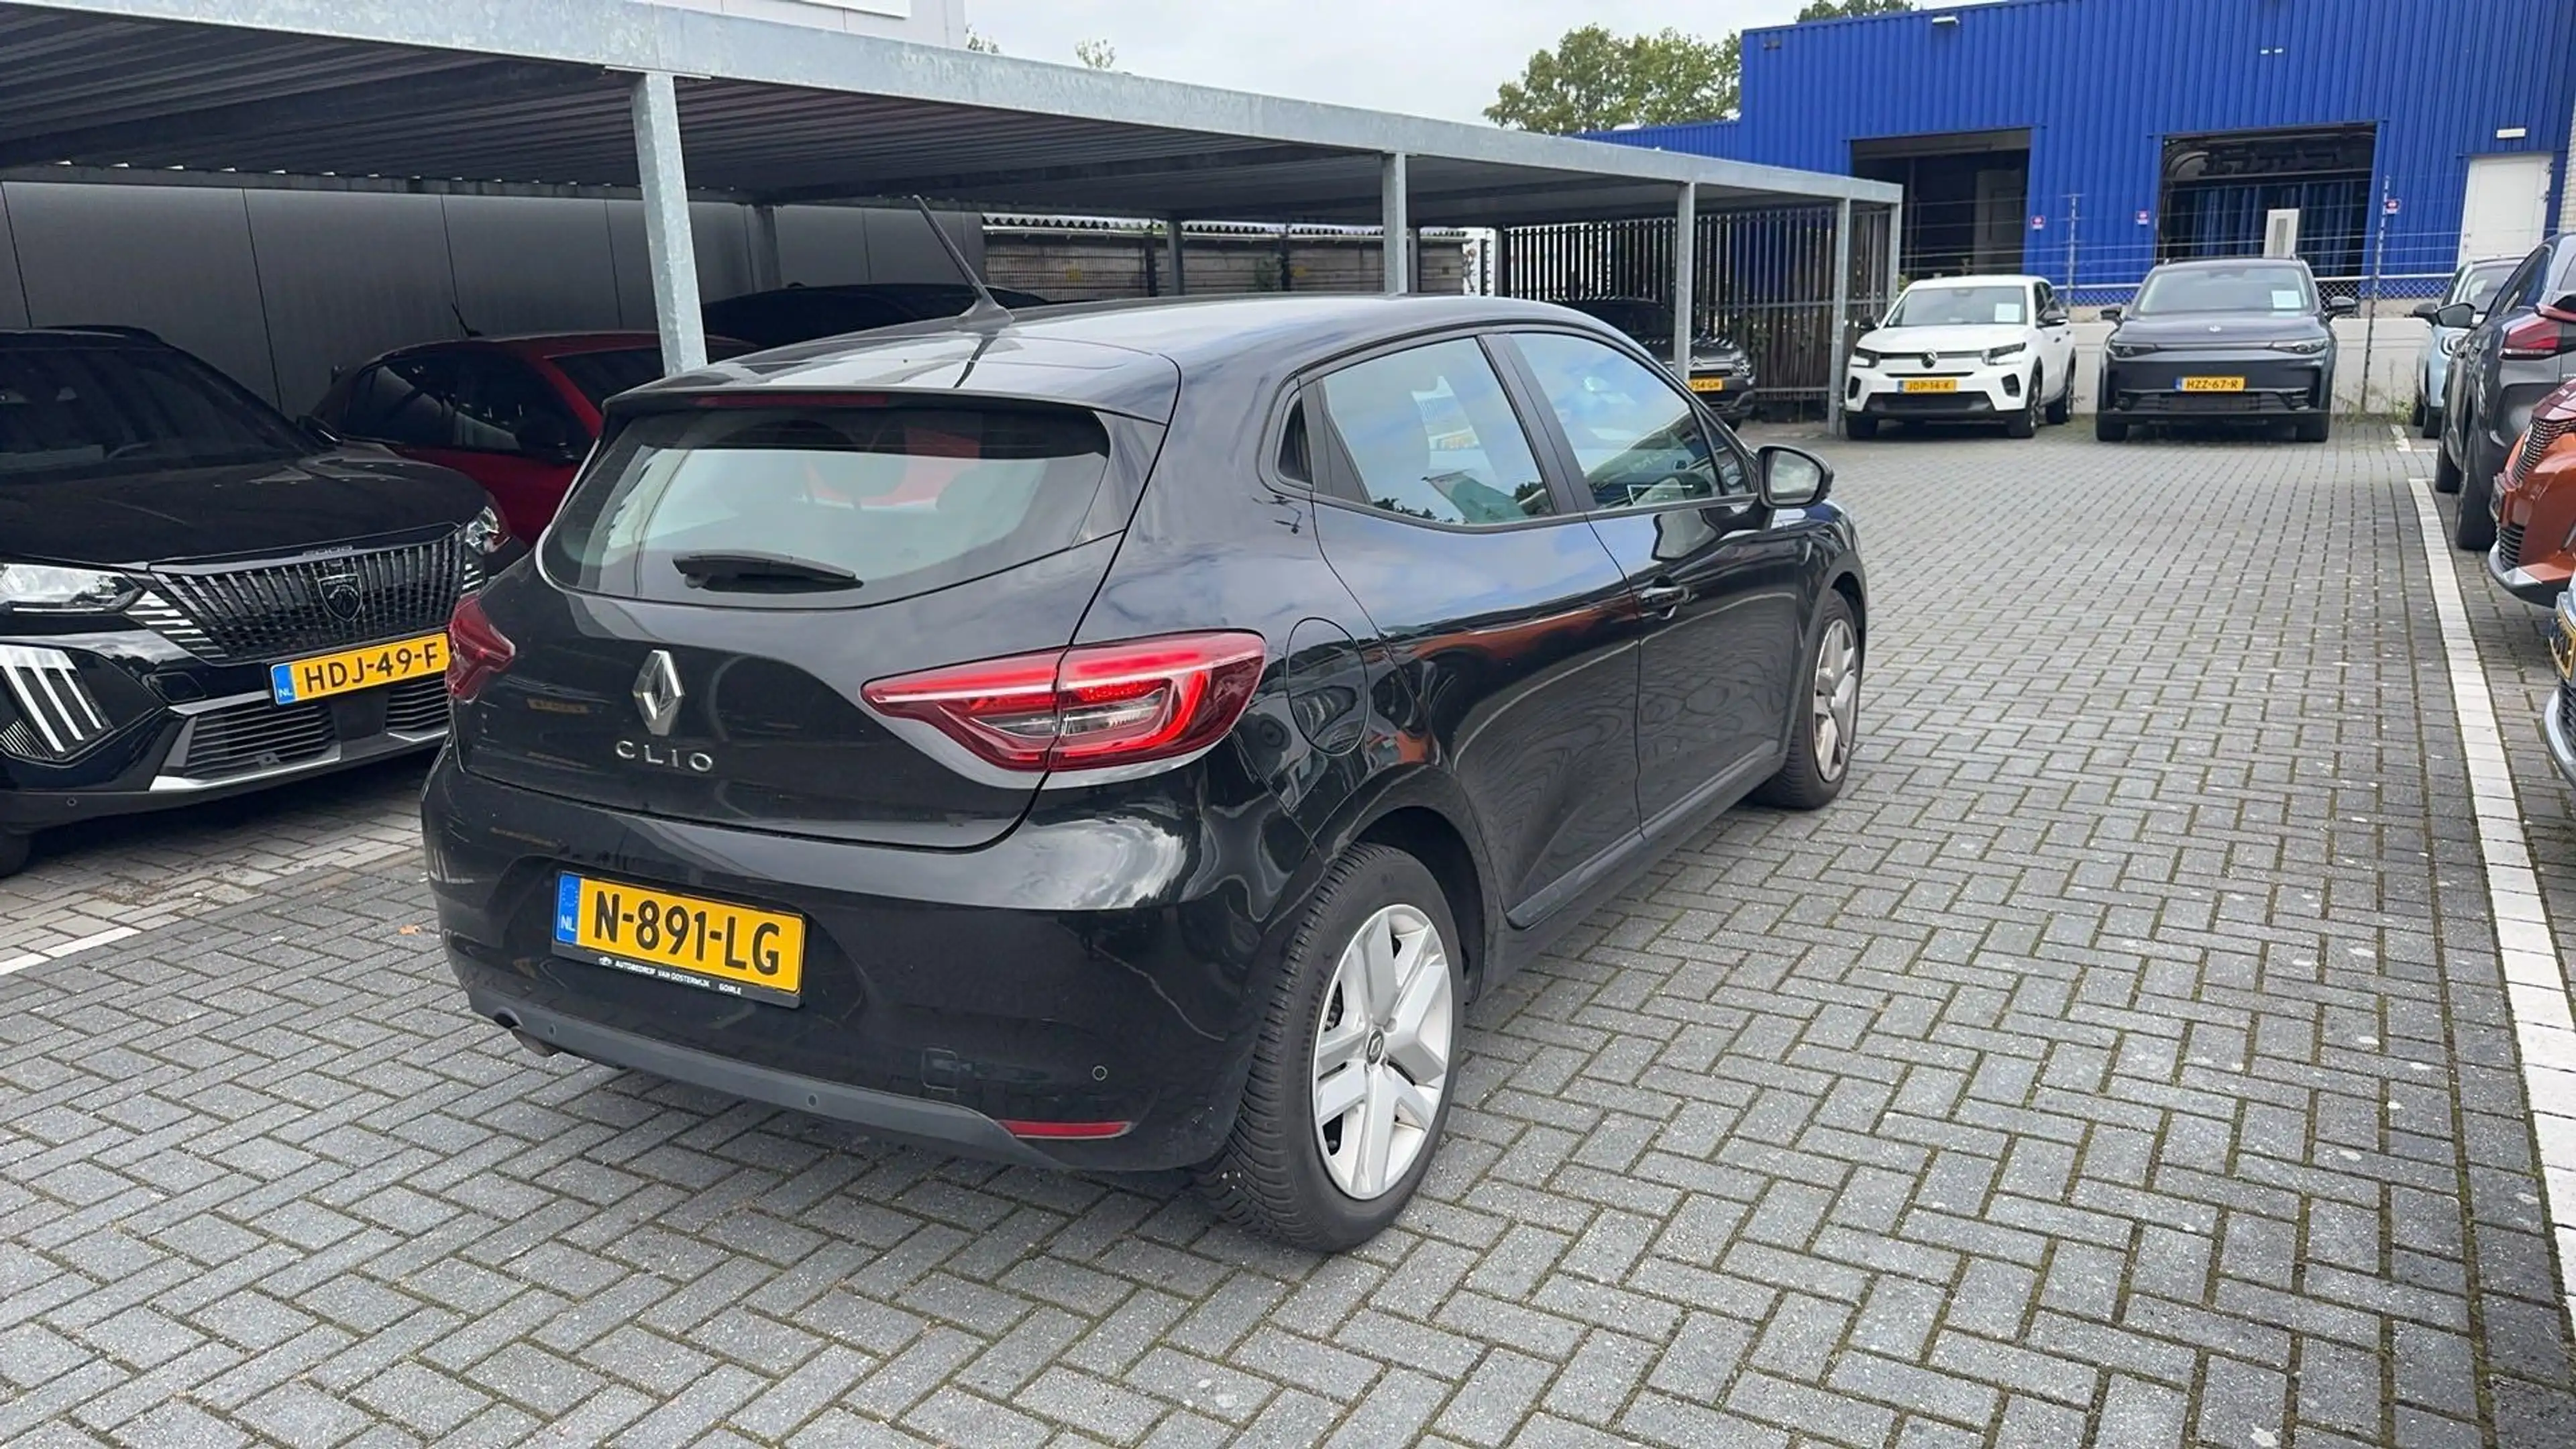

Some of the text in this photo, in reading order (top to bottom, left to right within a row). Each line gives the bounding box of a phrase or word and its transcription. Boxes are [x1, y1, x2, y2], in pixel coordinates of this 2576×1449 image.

[2186, 380, 2238, 389] HZZ-67-R
[303, 642, 437, 692] HDJ-49-F
[278, 688, 292, 696] NL
[615, 740, 713, 771] CLIO
[560, 914, 576, 932] NL
[594, 890, 780, 975] N-891-LG
[614, 960, 656, 975] AUTOBEDRIJF
[657, 969, 670, 979] VAN
[718, 983, 742, 996] GOIRLE
